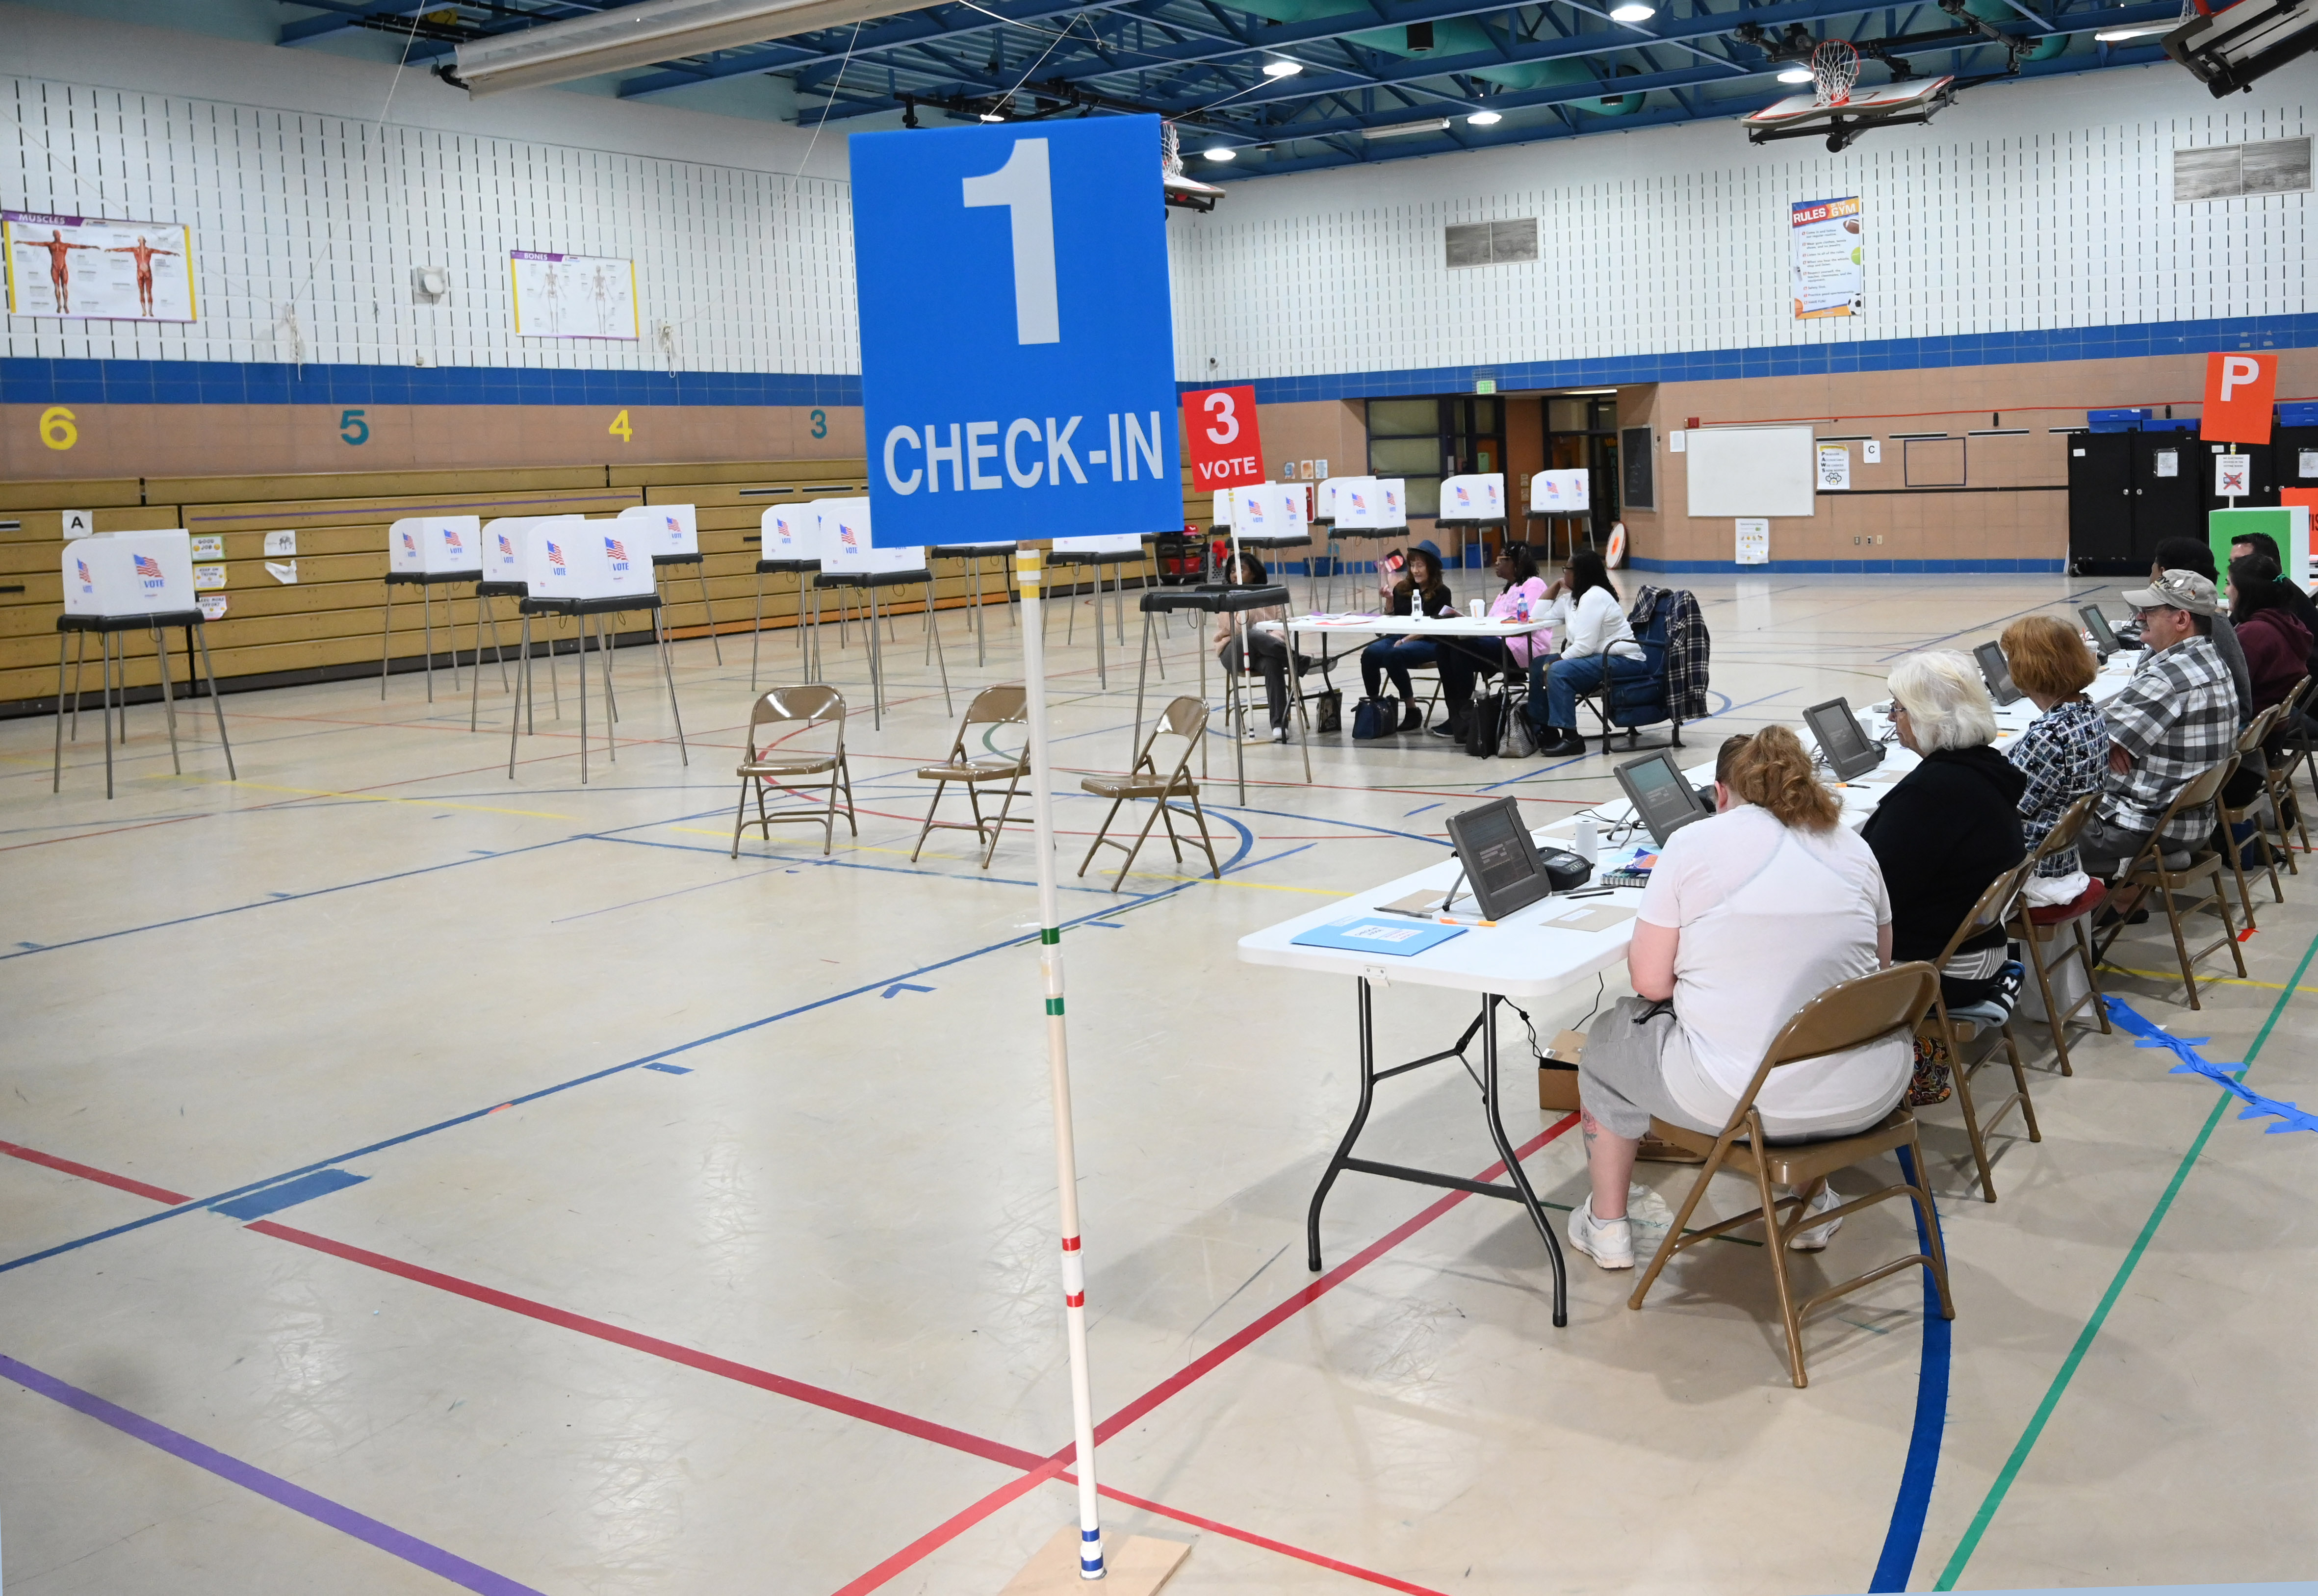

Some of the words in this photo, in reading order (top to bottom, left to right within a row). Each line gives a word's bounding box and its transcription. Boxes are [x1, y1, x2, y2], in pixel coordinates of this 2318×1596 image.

[19, 213, 65, 225] MUSCLES
[1793, 208, 1826, 223] RULES
[1831, 203, 1856, 217] GYM
[962, 137, 1060, 345] 1
[524, 252, 548, 260] BONES
[2220, 356, 2260, 402] P
[39, 406, 78, 450] 6
[340, 409, 369, 445] 5
[609, 410, 633, 442] 4
[811, 410, 827, 438] 3
[1204, 392, 1239, 445] 3
[884, 411, 1164, 495] CHECK-IN
[1868, 445, 1875, 454] C
[1199, 456, 1258, 480] VOTE
[71, 516, 84, 529] A
[553, 567, 567, 576] VOTE
[613, 563, 629, 571] VOTE
[144, 579, 164, 588] VOTE
